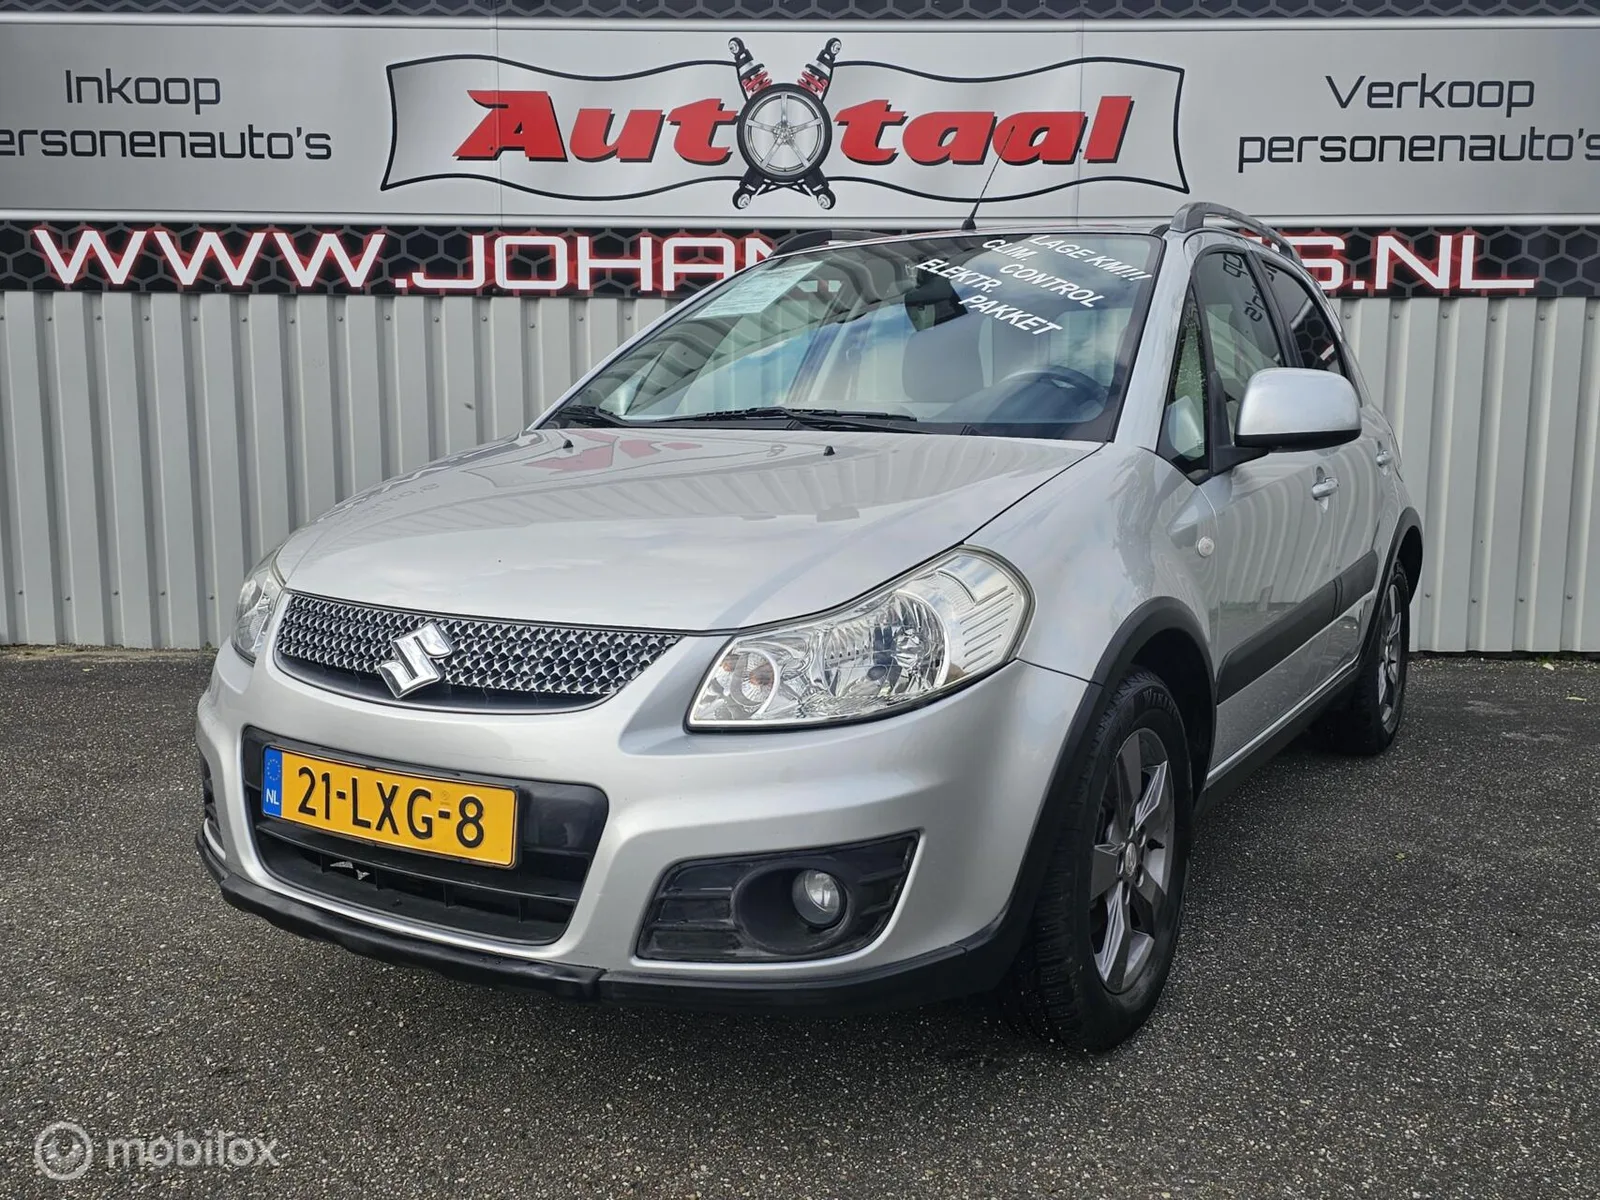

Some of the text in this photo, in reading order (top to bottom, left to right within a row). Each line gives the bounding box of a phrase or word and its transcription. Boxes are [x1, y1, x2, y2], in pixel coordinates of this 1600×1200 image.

[65, 68, 221, 115] Inkoop
[1325, 73, 1535, 118] Verkoop
[0, 124, 332, 160] ersonenauto's
[1238, 126, 1600, 173] personenauto's
[982, 239, 1038, 261] CLIM.
[1028, 234, 1095, 260] LAGE
[915, 258, 1003, 293] ELEKTR.
[999, 264, 1106, 308] CONTROL
[957, 294, 1063, 336] PAKKET
[265, 765, 485, 850] NL 21-LXG-8
